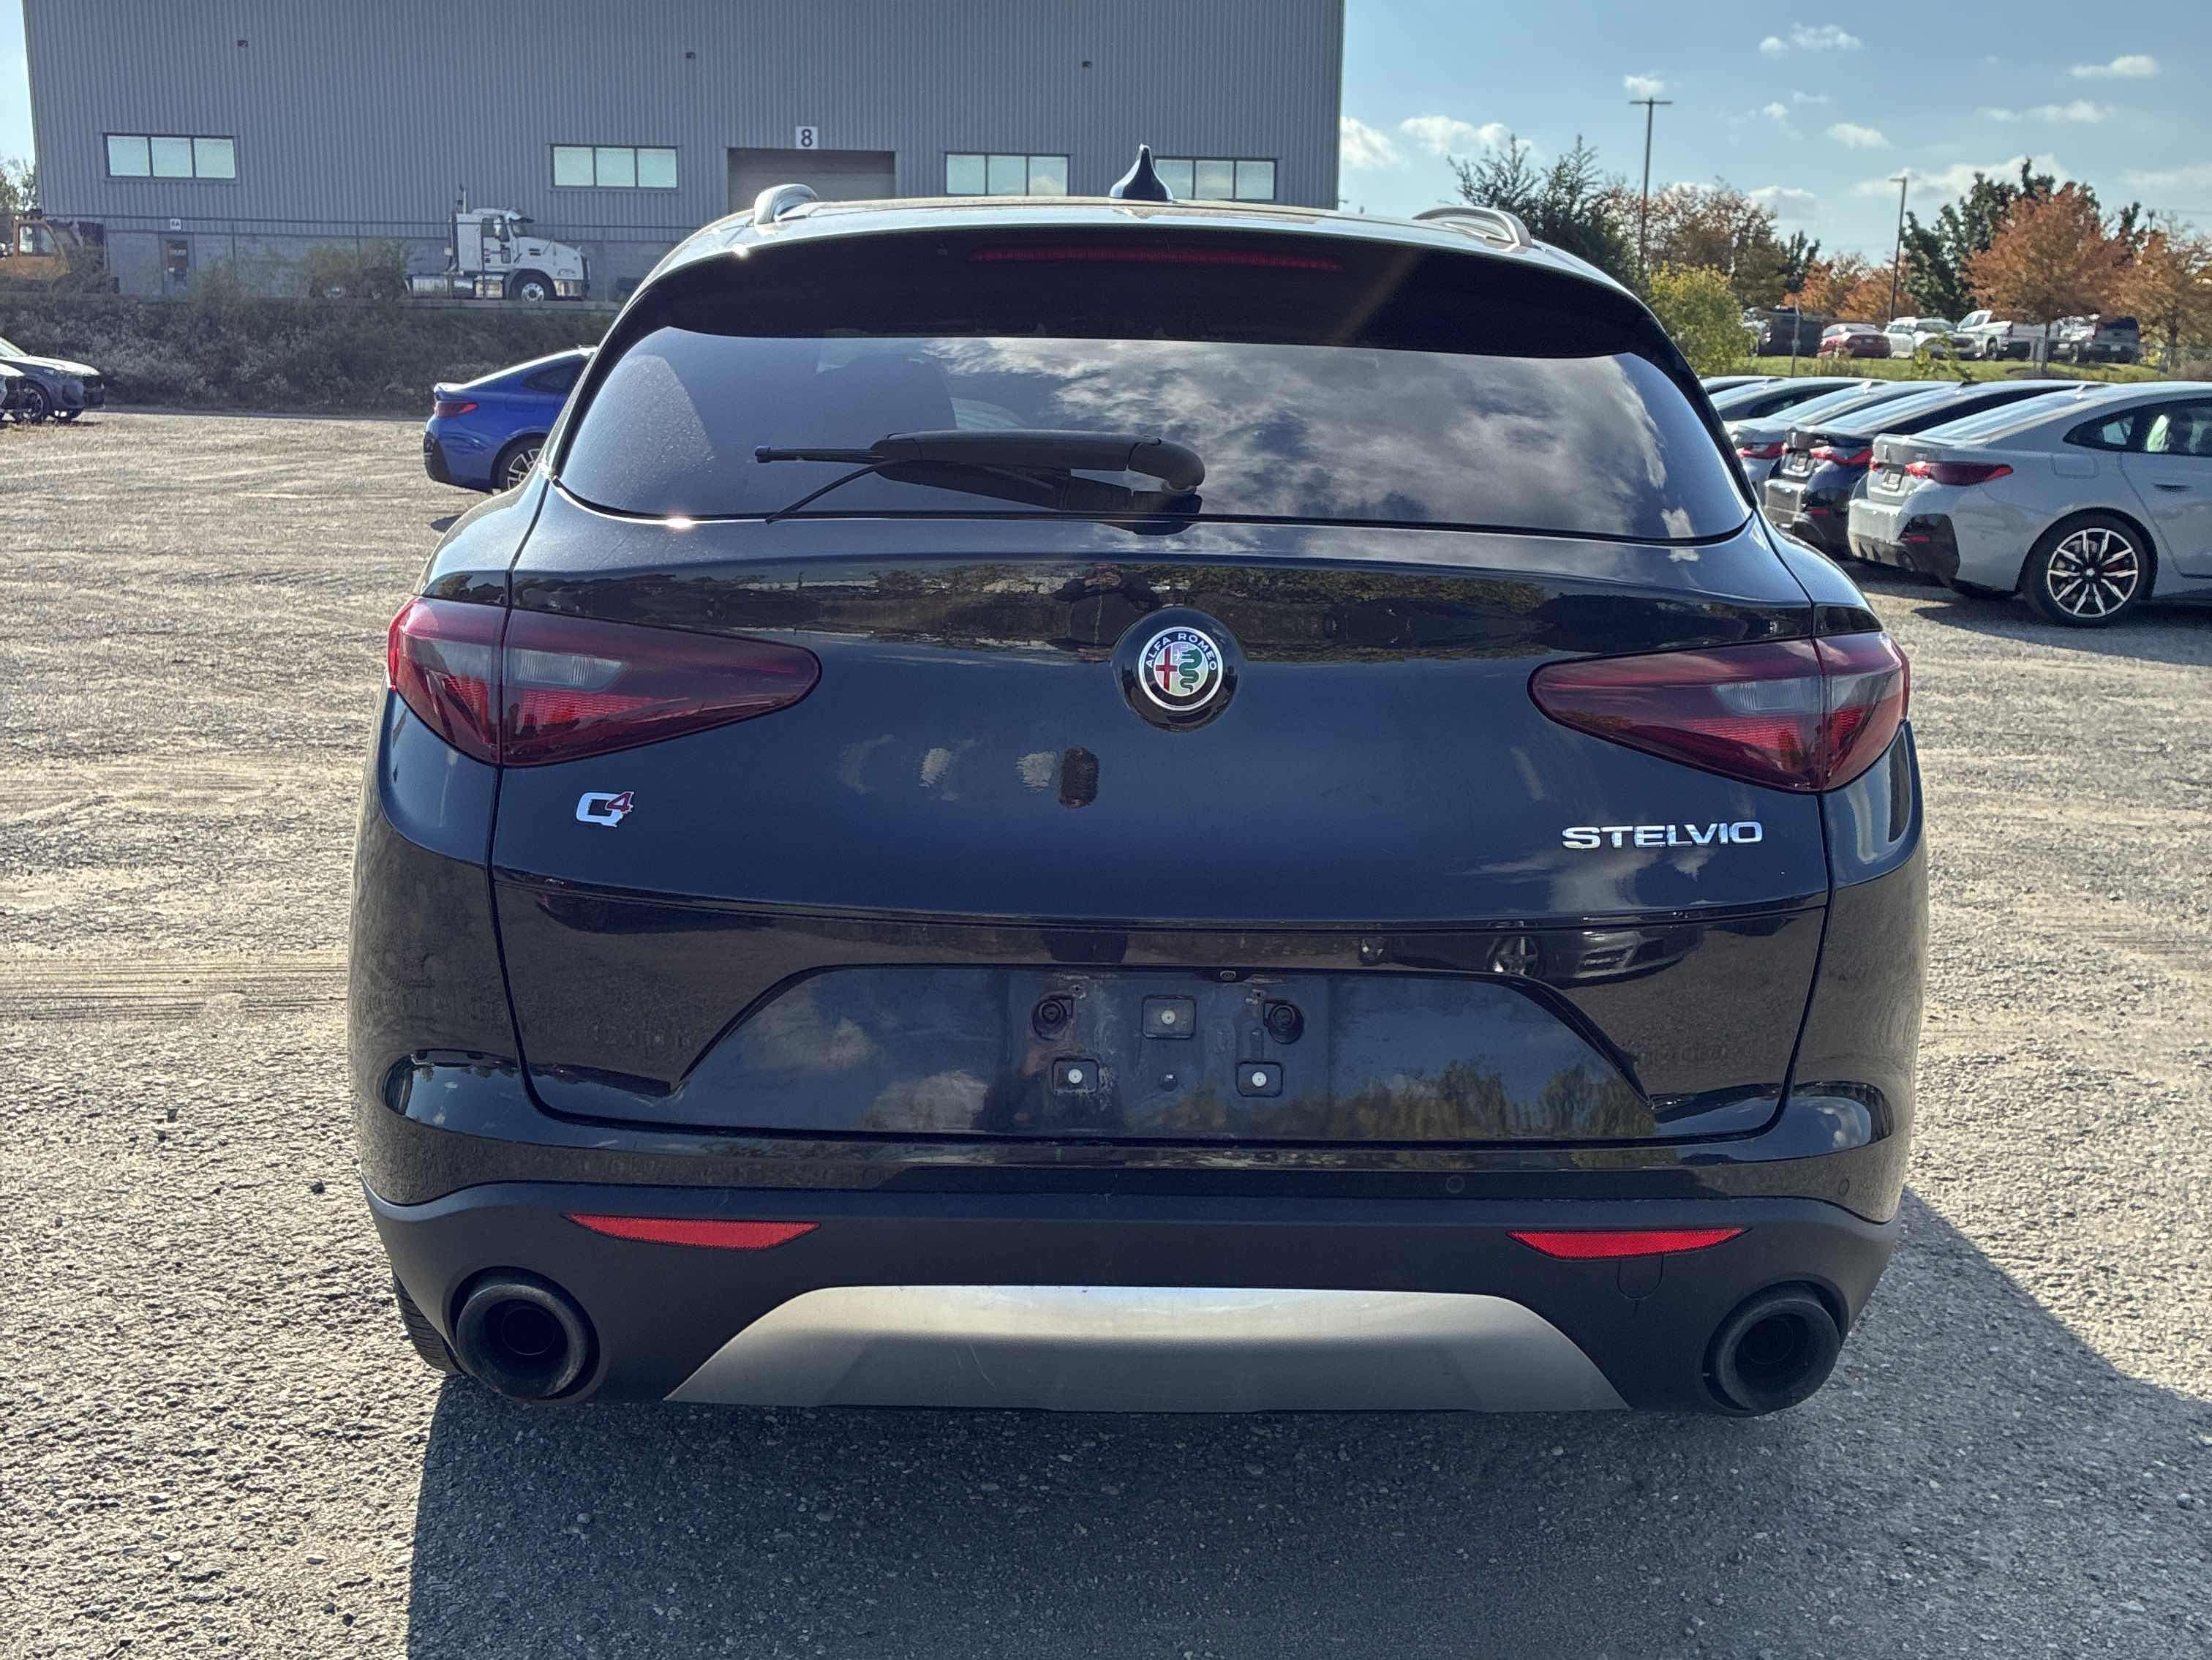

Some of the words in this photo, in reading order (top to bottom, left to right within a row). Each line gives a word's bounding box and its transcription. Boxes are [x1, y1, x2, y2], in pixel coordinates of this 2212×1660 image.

[801, 128, 813, 147] 8
[1146, 637, 1172, 669] ALFA
[1178, 633, 1217, 671] ROMEO
[576, 791, 634, 827] Q4
[1562, 821, 1763, 849] STELVIO
